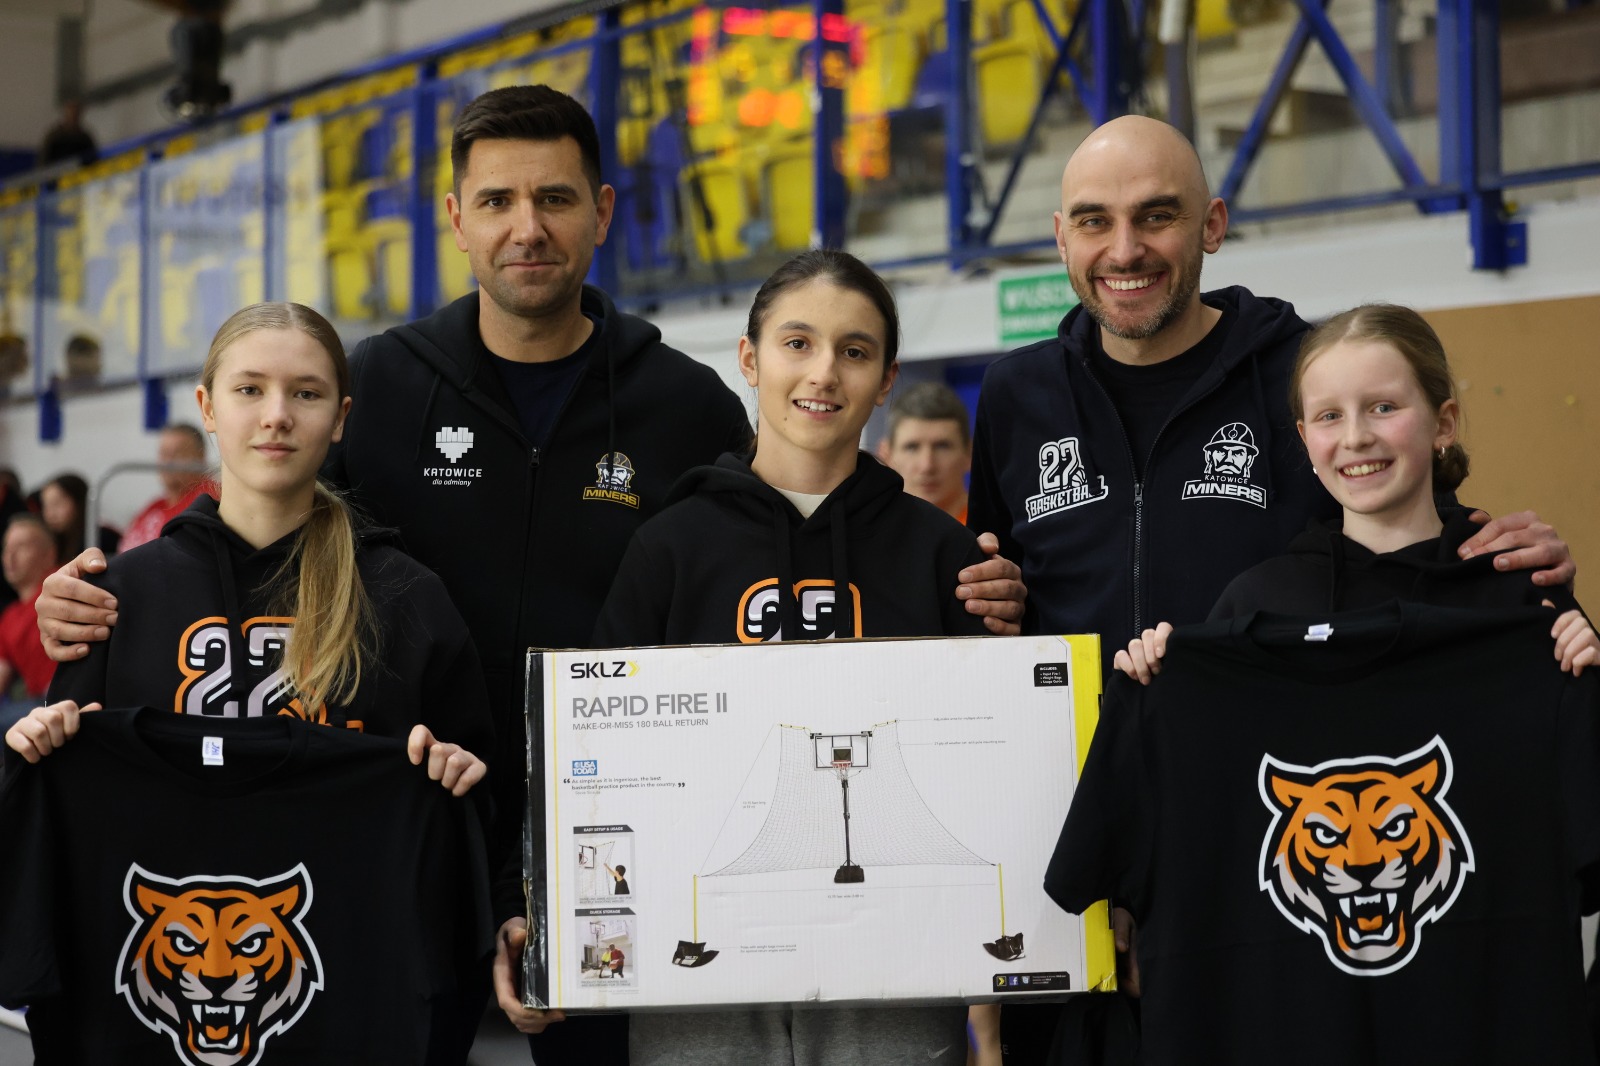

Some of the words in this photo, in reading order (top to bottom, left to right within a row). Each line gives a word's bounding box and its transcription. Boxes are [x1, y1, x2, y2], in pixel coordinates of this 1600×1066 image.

[423, 467, 483, 477] KATOWICE
[1040, 439, 1078, 491] 27
[443, 478, 472, 488] odmiany
[1204, 474, 1249, 485] KATOWICE
[585, 489, 637, 505] MINERS
[1029, 484, 1094, 517] BASKETBA
[1186, 482, 1263, 503] MINERS
[570, 661, 627, 679] SKLZ
[572, 695, 649, 718] RAPID
[656, 692, 709, 715] FIRE
[716, 692, 728, 713] II
[572, 721, 634, 731] MAKE-OR-MISS
[653, 719, 673, 728] BALL
[675, 718, 709, 727] RETURN
[573, 767, 596, 775] TODAY
